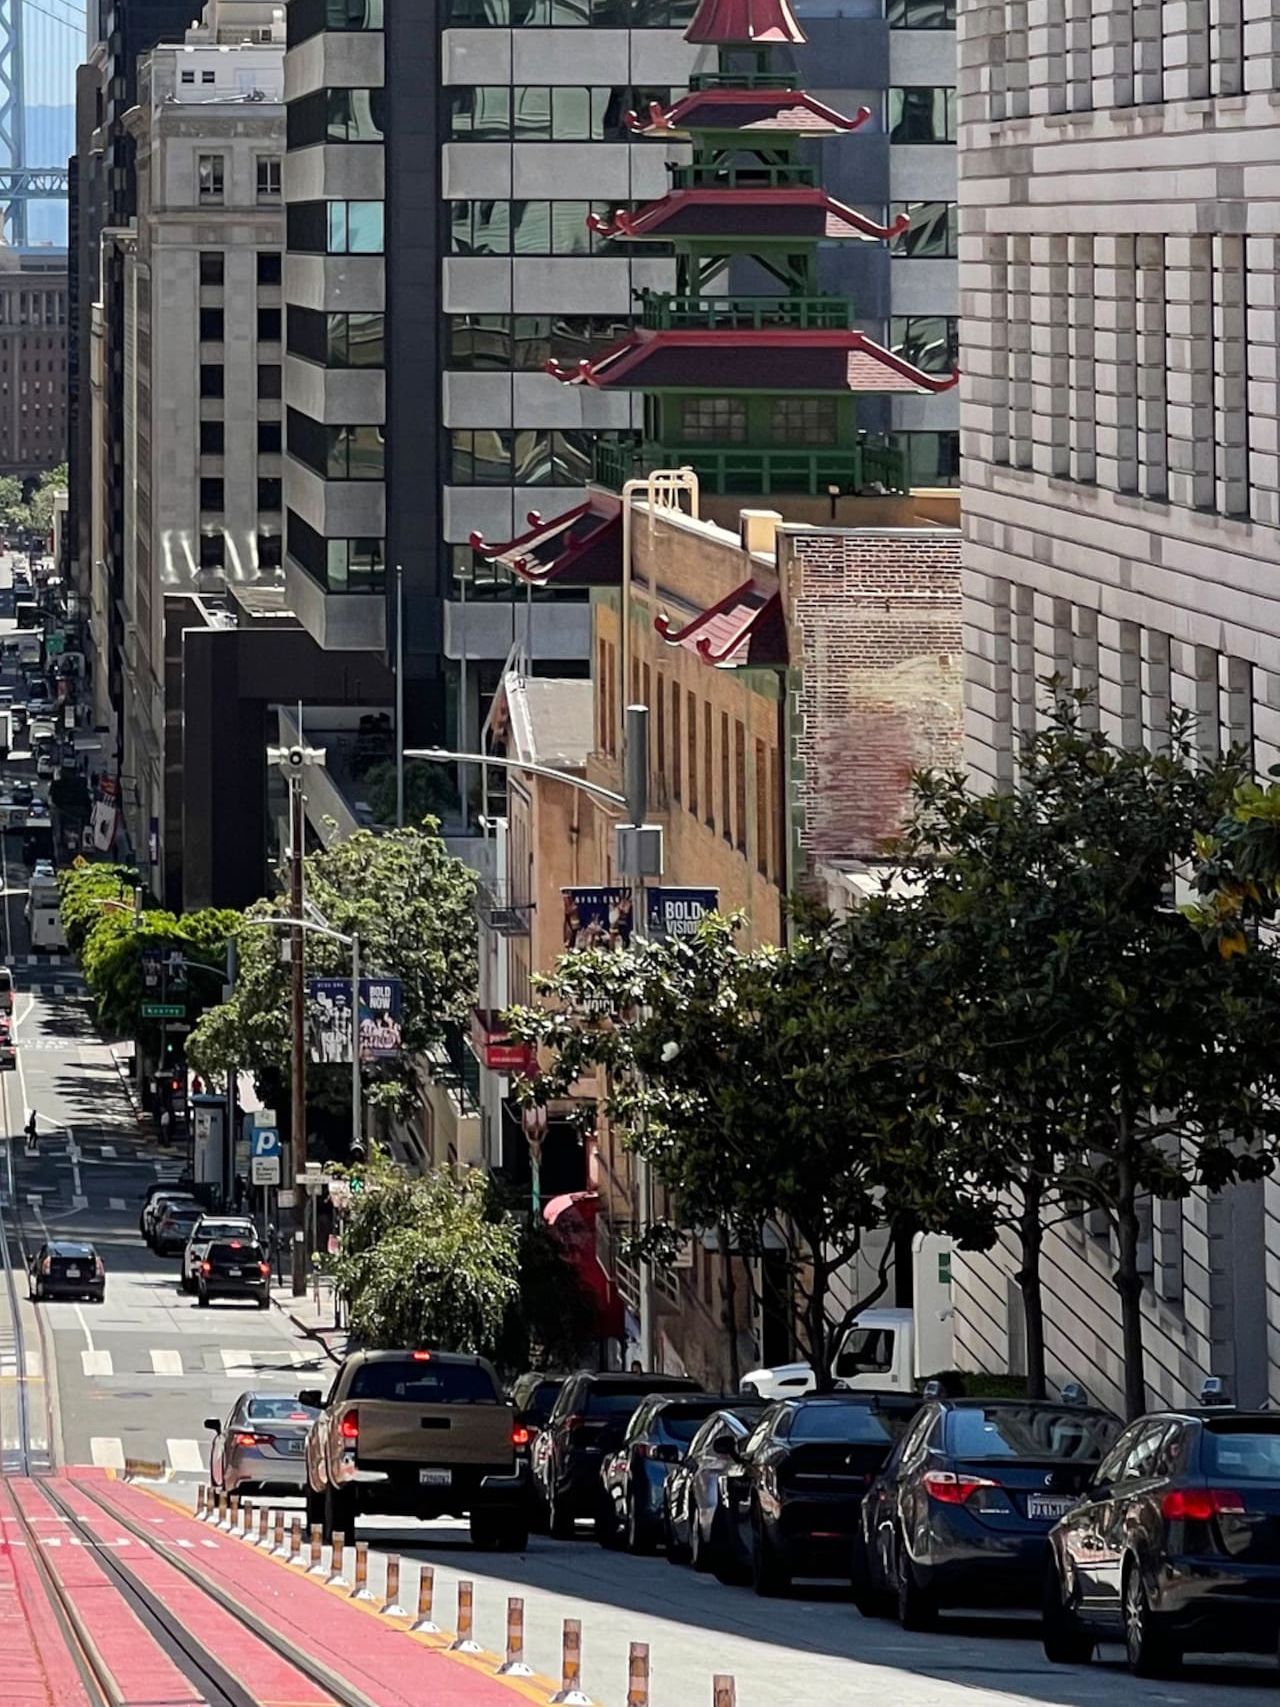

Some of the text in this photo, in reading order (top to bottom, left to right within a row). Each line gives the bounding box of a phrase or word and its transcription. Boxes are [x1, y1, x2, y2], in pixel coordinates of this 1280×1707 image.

[665, 901, 701, 920] BOLD
[369, 986, 391, 998] BOLD
[369, 997, 391, 1009] NOW
